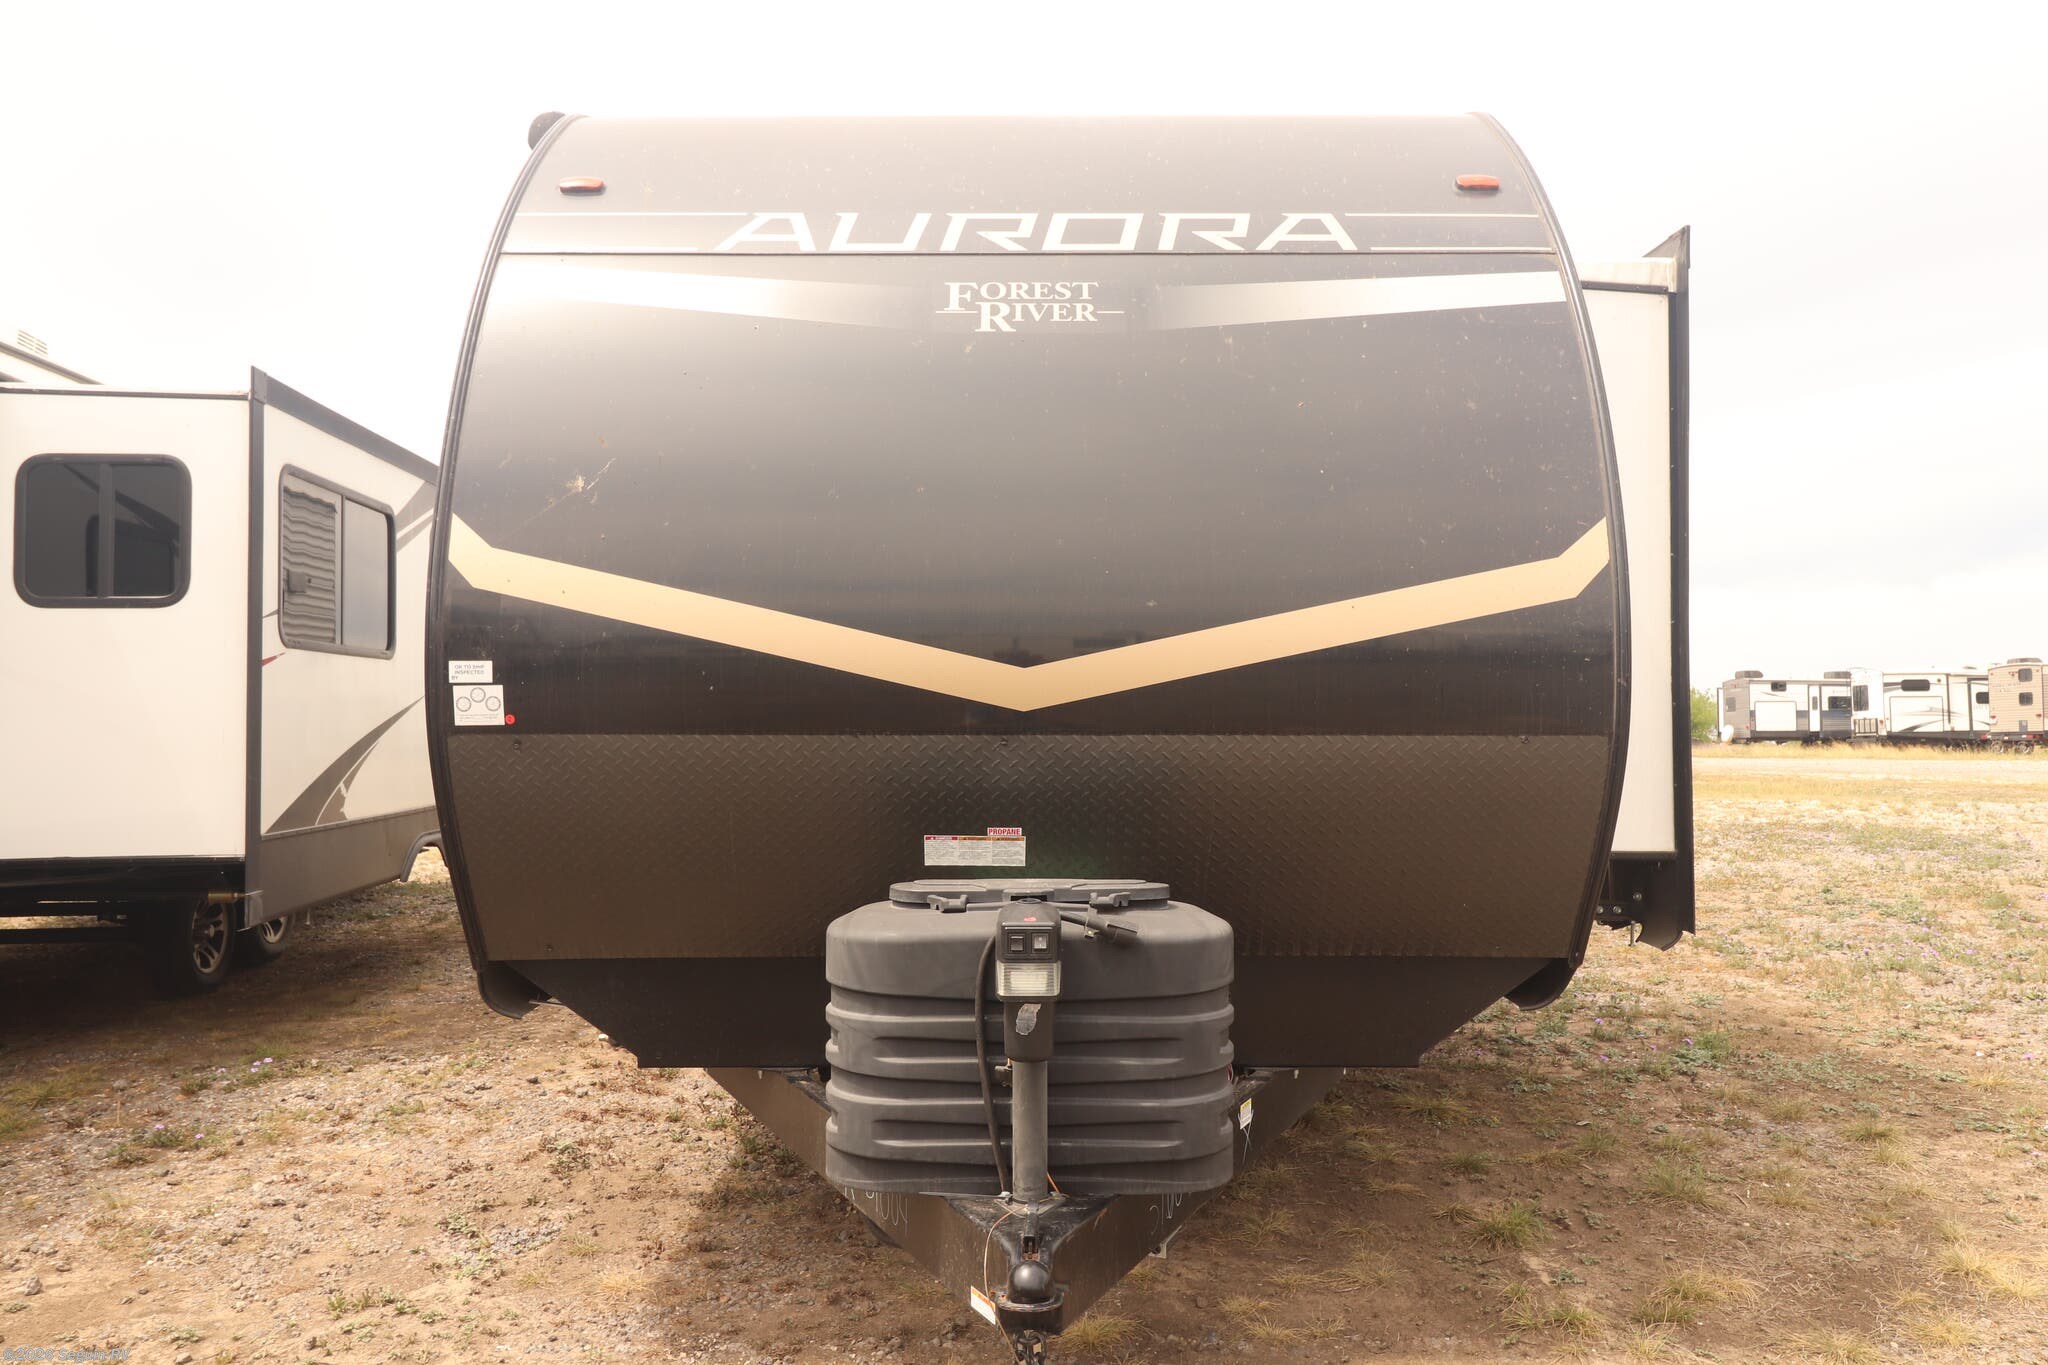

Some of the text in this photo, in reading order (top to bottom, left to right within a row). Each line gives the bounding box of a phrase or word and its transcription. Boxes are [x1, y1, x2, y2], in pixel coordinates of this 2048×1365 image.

[715, 211, 1359, 252] AURORA
[943, 282, 1099, 311] FOREST
[974, 301, 1098, 332] RIVER
